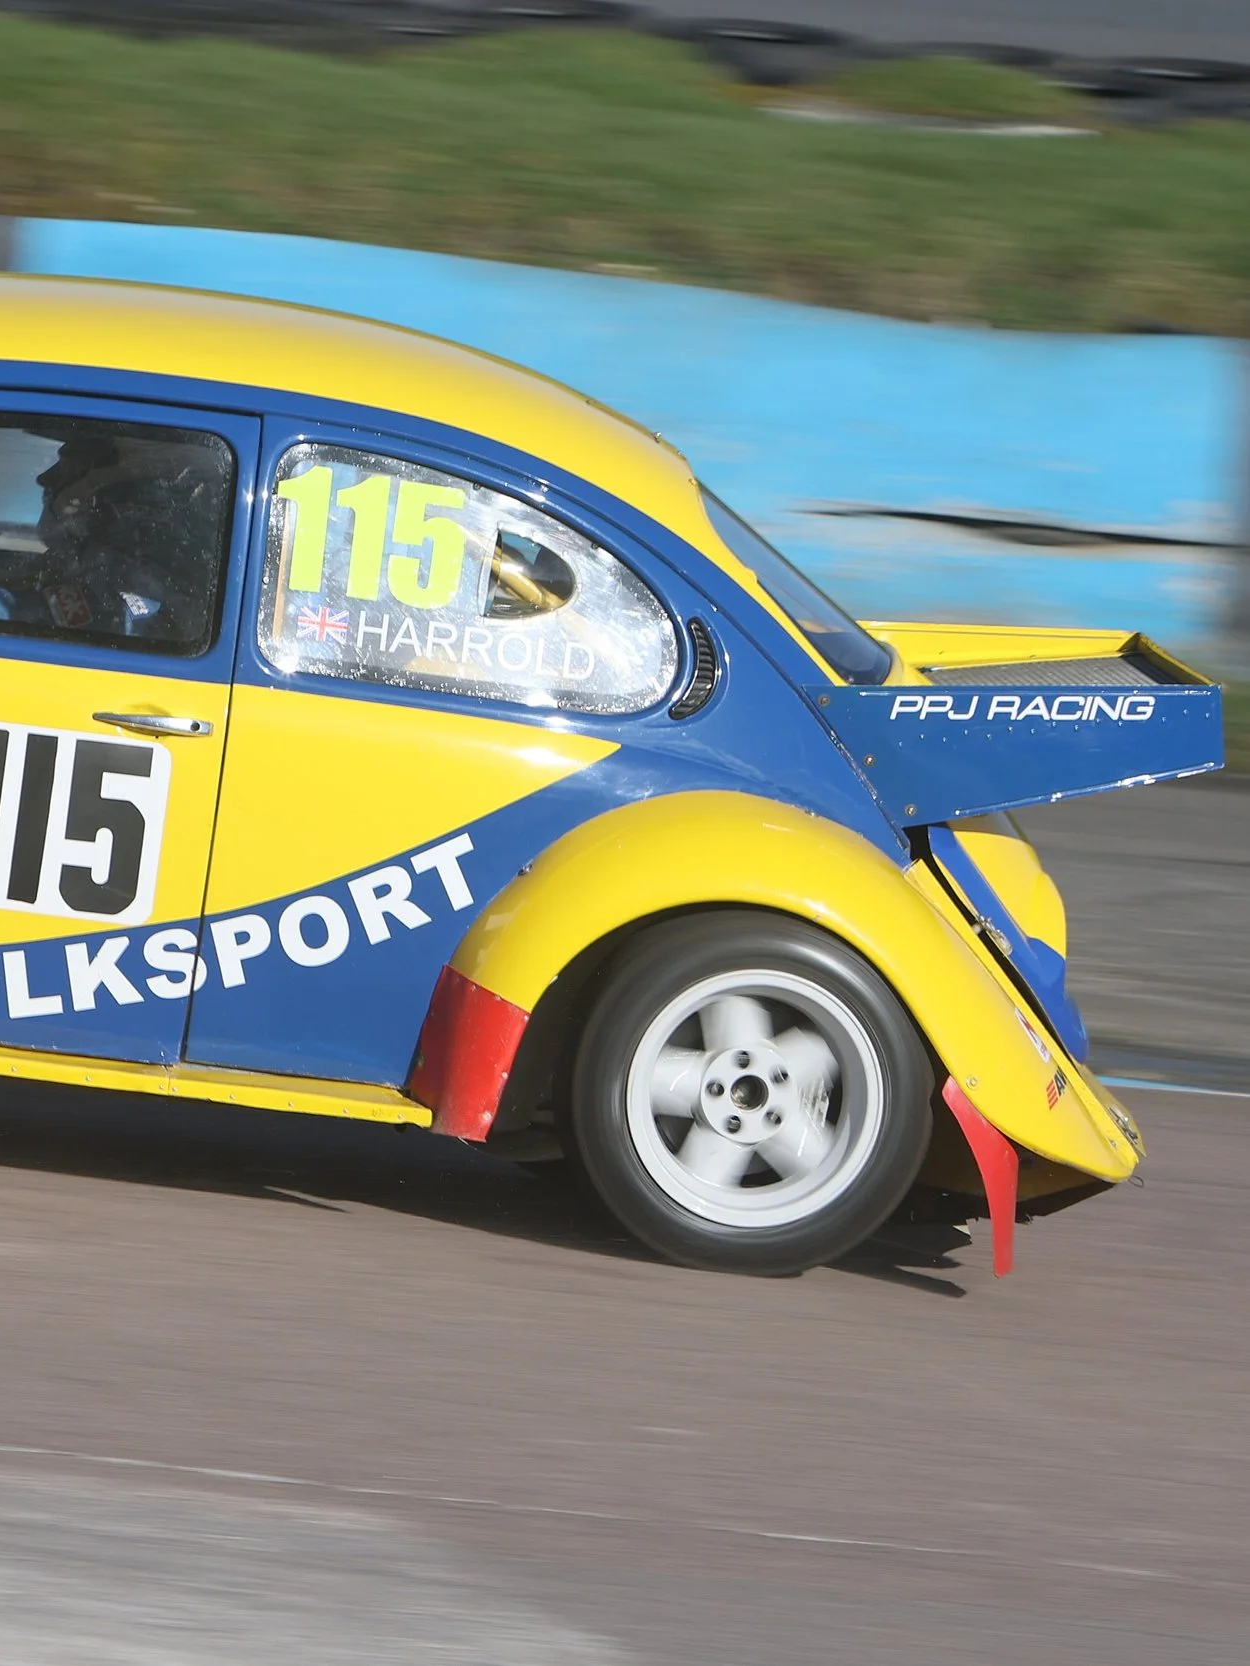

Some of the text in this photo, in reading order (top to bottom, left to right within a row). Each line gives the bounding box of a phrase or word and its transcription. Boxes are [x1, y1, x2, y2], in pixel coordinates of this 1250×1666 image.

[277, 465, 466, 610] 115
[357, 610, 596, 681] HARROLD
[889, 695, 1157, 721] PPJ RACING
